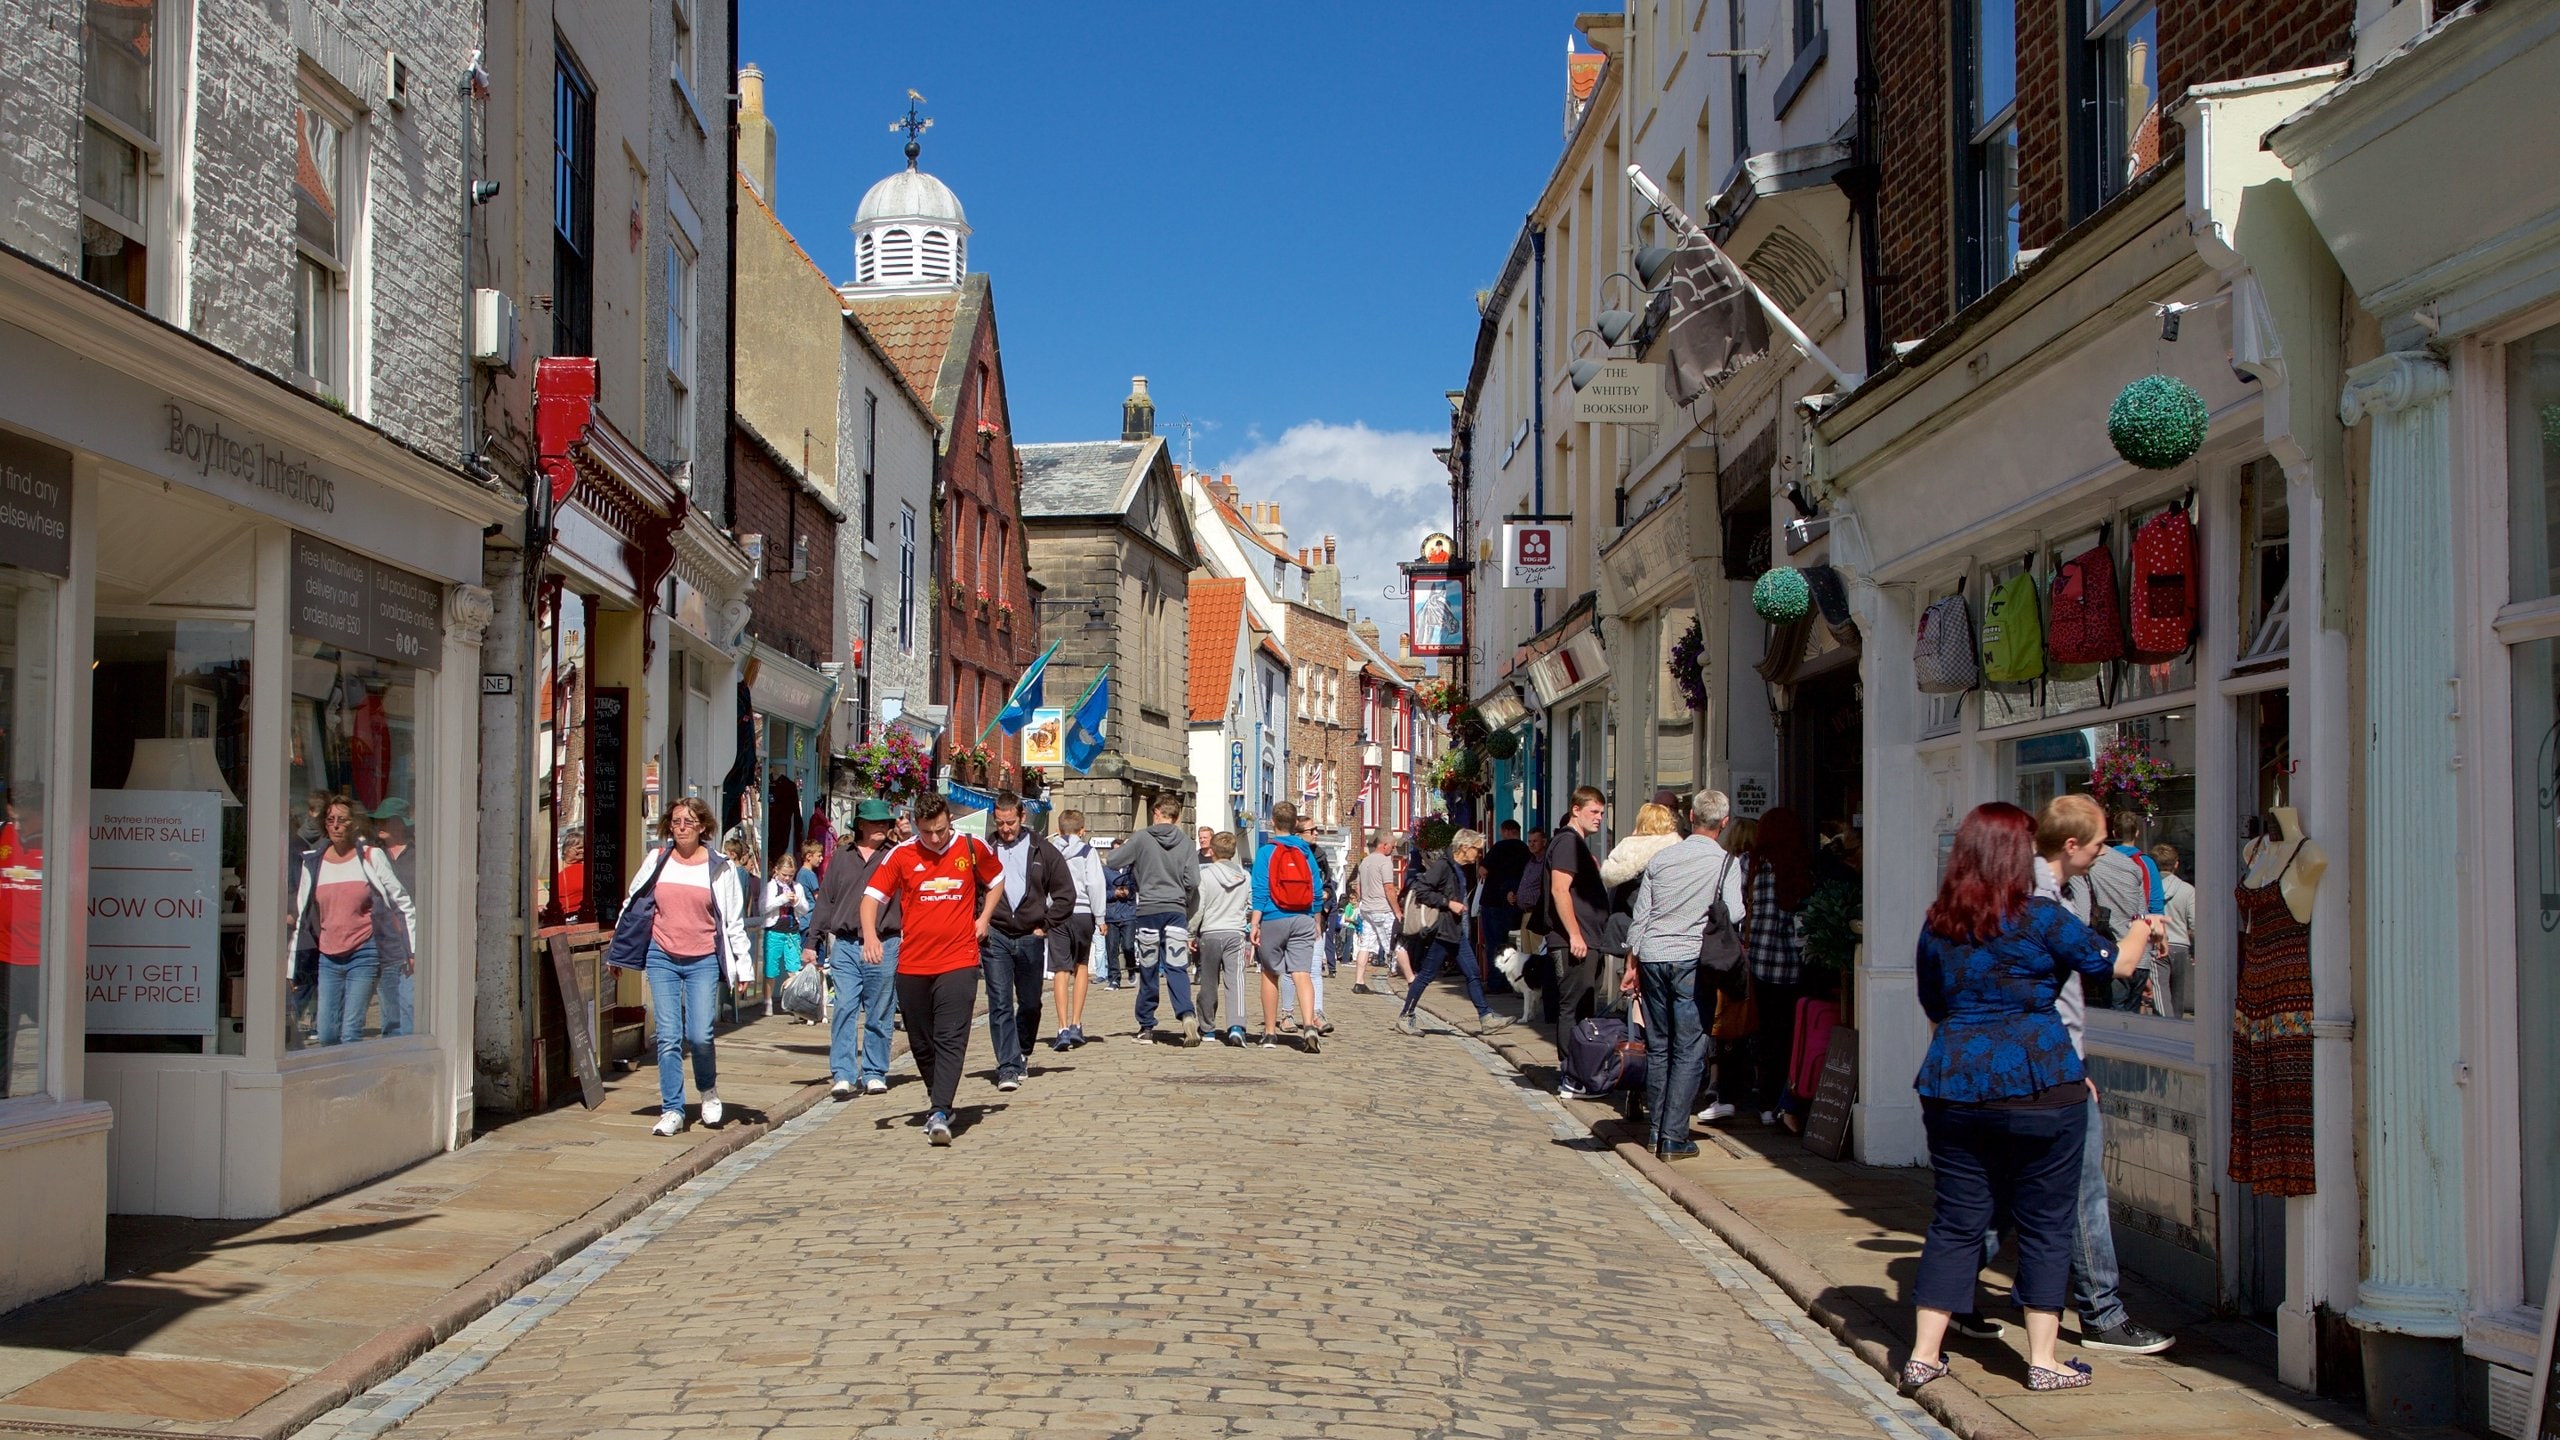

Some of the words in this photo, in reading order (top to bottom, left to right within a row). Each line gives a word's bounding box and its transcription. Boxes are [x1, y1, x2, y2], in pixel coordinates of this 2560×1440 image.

[1604, 368, 1628, 378] THE
[1592, 386, 1641, 396] WHITBY
[1583, 404, 1649, 414] BOOKSHOP
[165, 404, 256, 482] Baytree
[256, 443, 335, 514] Interiors
[6, 466, 32, 495] find
[35, 480, 59, 508] any
[0, 502, 65, 539] elsewhere
[300, 545, 319, 568] Free
[320, 551, 364, 583] Nationwide
[1514, 565, 1556, 576] Discover
[1526, 572, 1544, 585] Life
[306, 576, 337, 605] delivery
[338, 588, 349, 604] on
[349, 590, 359, 608] all
[376, 571, 388, 591] Full
[388, 579, 417, 599] product
[418, 587, 439, 610] range
[303, 605, 328, 627] orders
[329, 615, 346, 632] over
[379, 601, 413, 625] available
[413, 610, 435, 630] online
[483, 678, 505, 689] NE
[1232, 743, 1242, 790] CAFE
[104, 814, 142, 825] Baytree
[144, 816, 182, 825] Interiors
[89, 826, 155, 841] UMMER
[160, 828, 205, 843] SALE!
[920, 894, 962, 902] CHEVROLET
[88, 897, 147, 918] NOW
[154, 898, 202, 919] ON!
[127, 965, 133, 982] 1
[142, 965, 183, 982] GET
[191, 965, 198, 982] 1
[135, 986, 201, 1003] PRICE!
